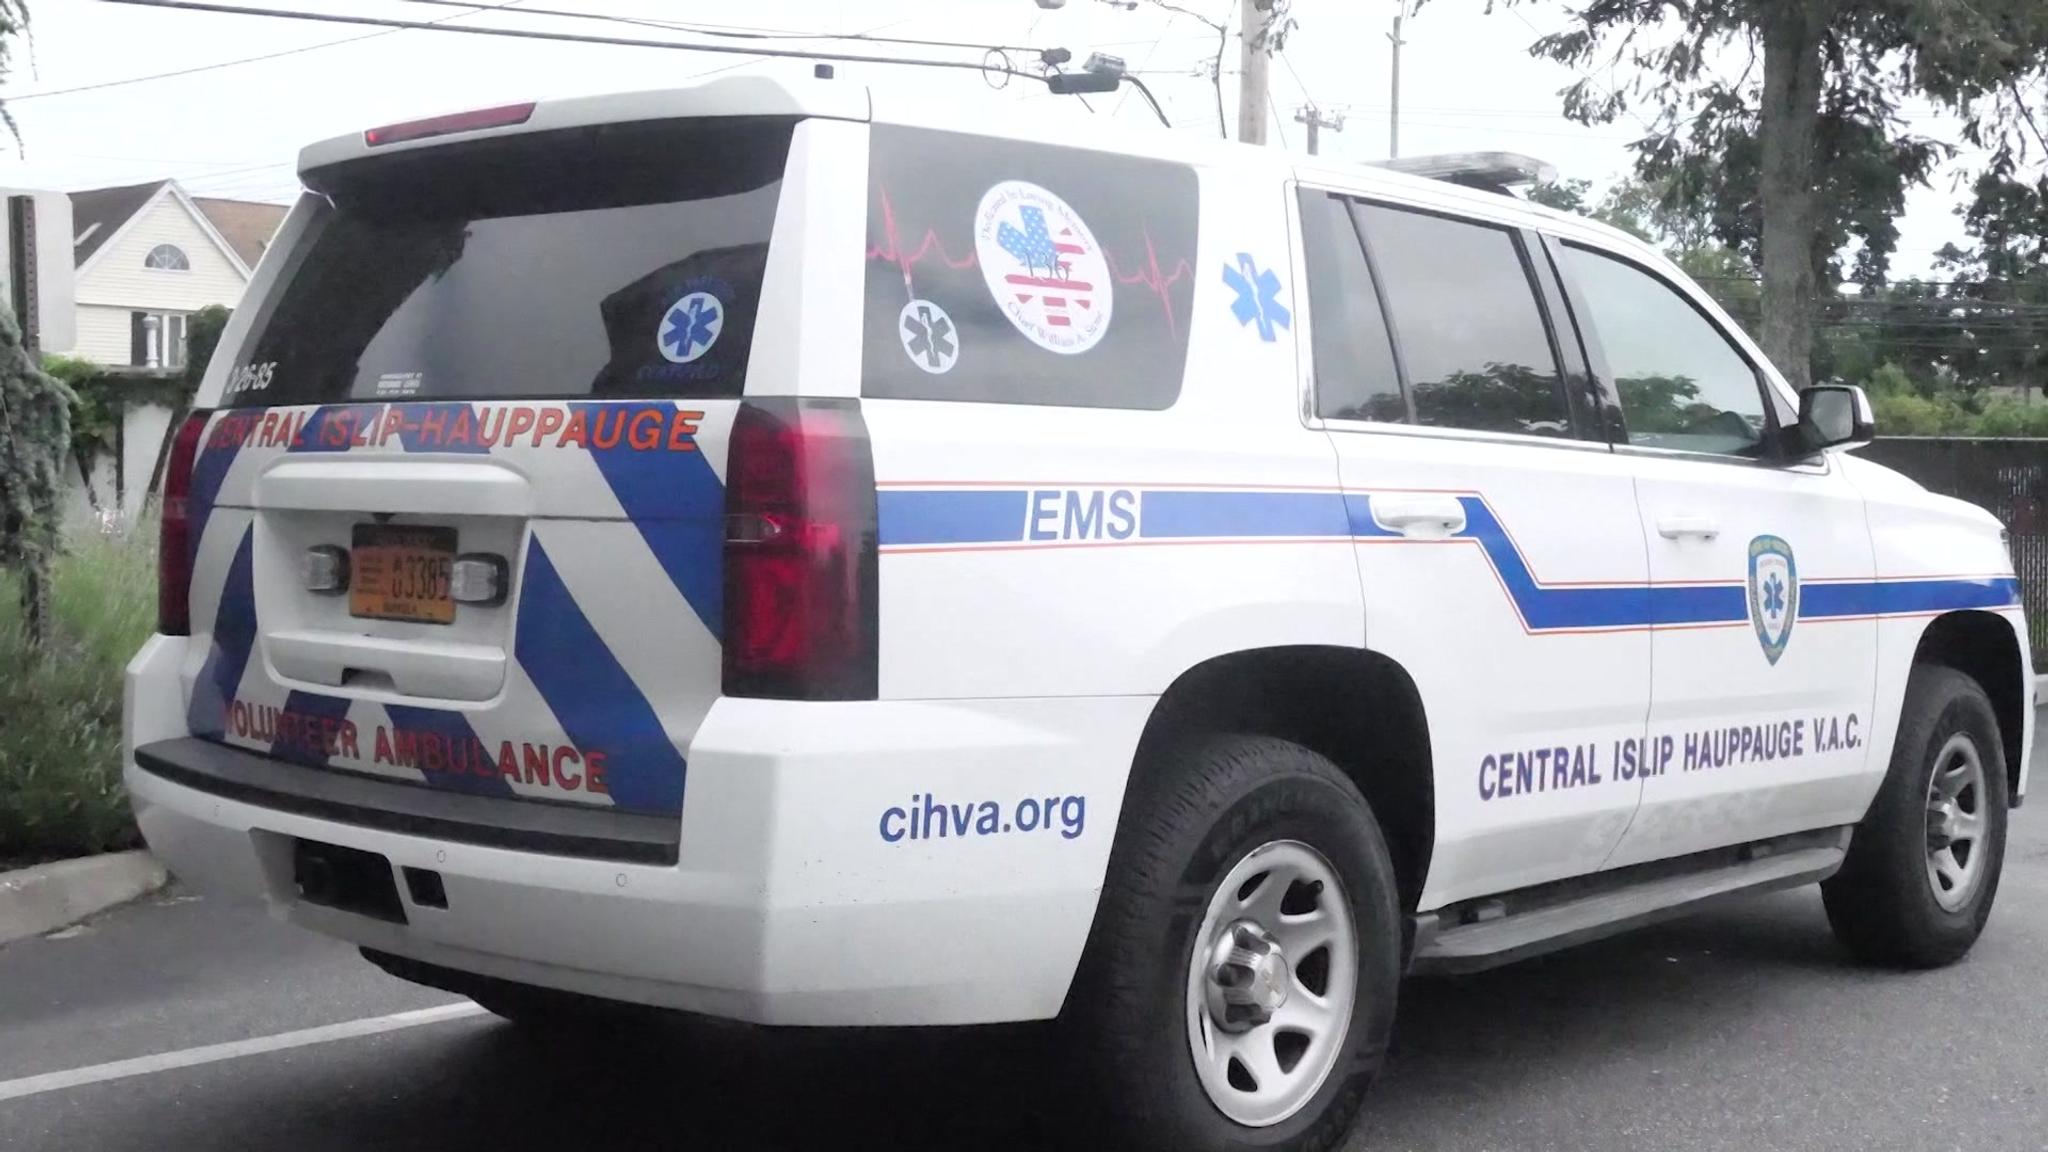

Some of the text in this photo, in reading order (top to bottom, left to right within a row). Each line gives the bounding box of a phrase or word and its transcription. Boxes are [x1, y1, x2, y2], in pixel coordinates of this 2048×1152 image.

[208, 407, 705, 452] CENTRAL ISLIP-HAUPPAUGE
[1029, 489, 1136, 541] EMS
[222, 699, 609, 794] VOLUNTEER AMBULANCE
[1478, 713, 1862, 801] CENTRAL ISLIP HAUPPAUGE V.A.C.
[879, 793, 1085, 843] cihva.org
